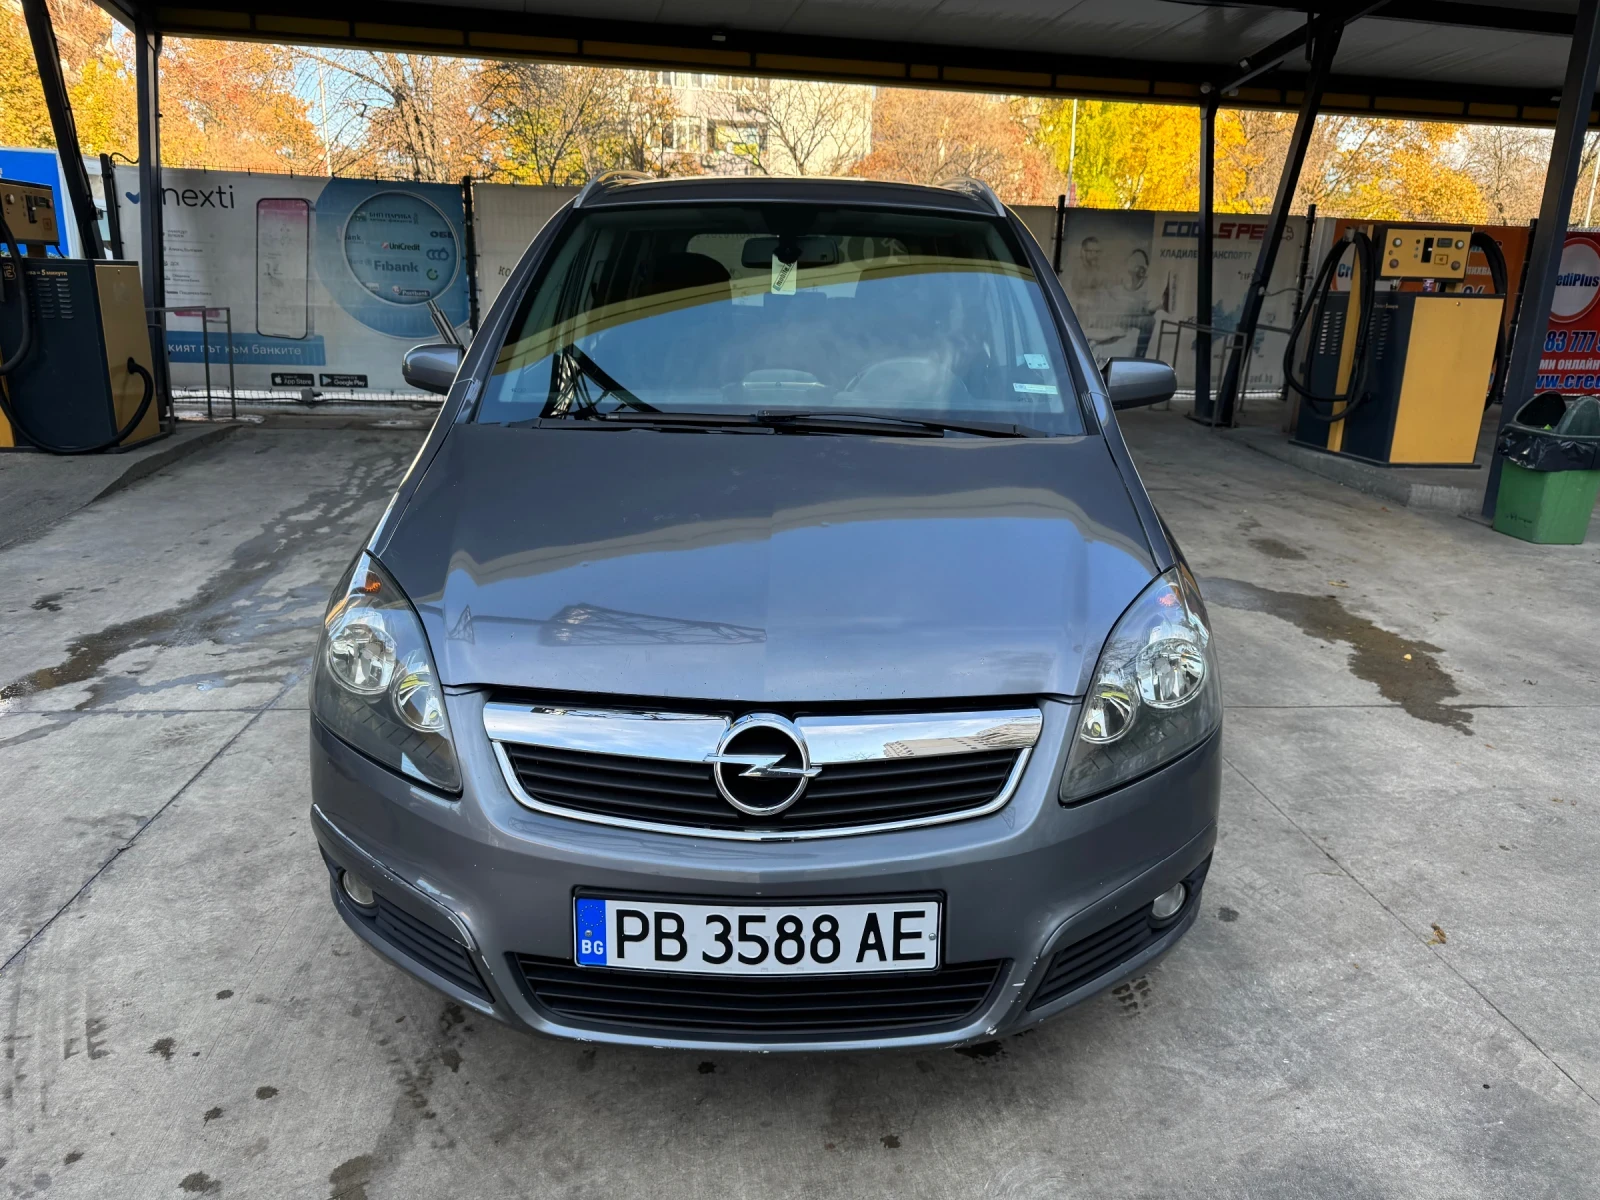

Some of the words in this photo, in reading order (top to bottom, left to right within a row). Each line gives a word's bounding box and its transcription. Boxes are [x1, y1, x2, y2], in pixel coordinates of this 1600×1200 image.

[161, 185, 235, 209] nexti
[389, 242, 421, 252] UniCredit
[1160, 248, 1199, 260] ХЛАДИЛЕ
[1211, 250, 1252, 261] АНСПОРТ?
[374, 260, 419, 273] Fibank
[1556, 273, 1600, 288] ediPlus
[1544, 330, 1568, 352] 83
[1568, 330, 1597, 352] 777
[168, 344, 197, 353] кият
[252, 344, 302, 356] банките
[1539, 359, 1556, 371] МИ
[334, 379, 352, 387] Google
[581, 939, 604, 956] BG
[616, 909, 688, 962] PB
[702, 914, 841, 965] 3588
[856, 910, 926, 963] AE
